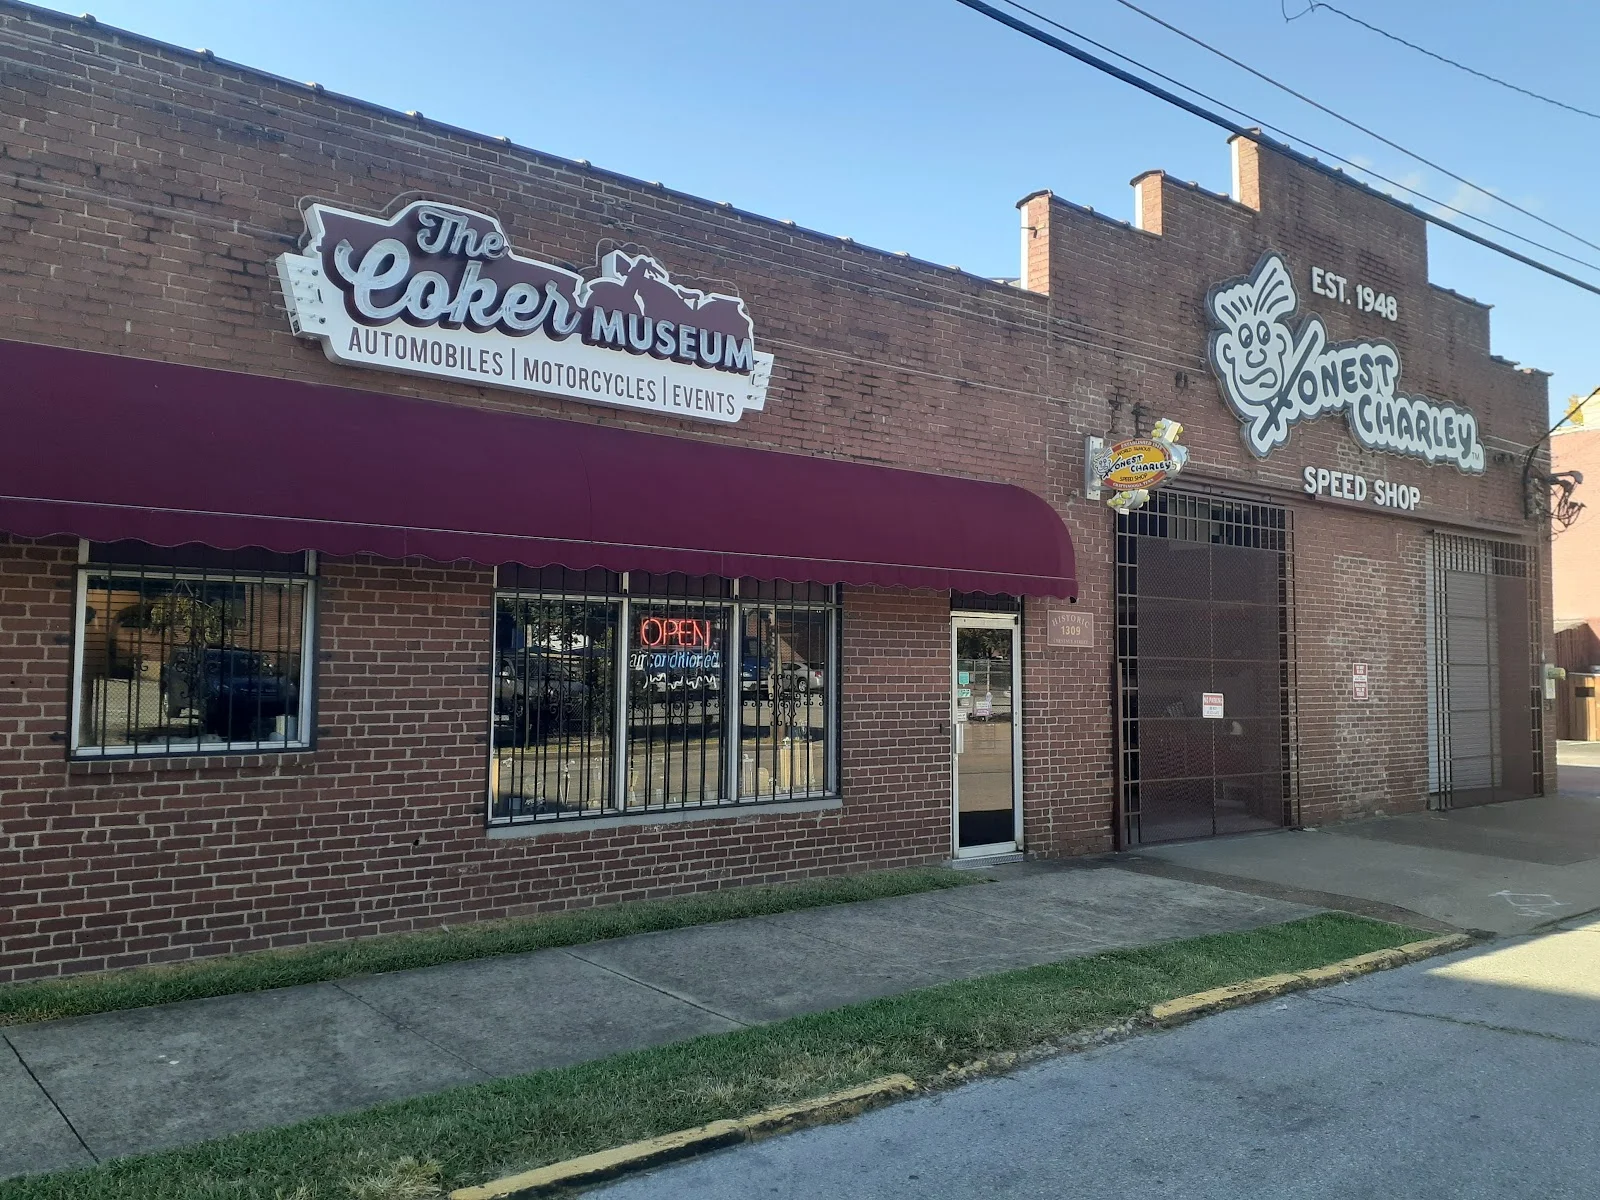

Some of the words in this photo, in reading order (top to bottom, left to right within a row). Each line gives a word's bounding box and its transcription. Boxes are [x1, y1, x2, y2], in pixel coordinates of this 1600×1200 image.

[416, 206, 508, 260] The
[334, 238, 581, 336] Coker
[1312, 266, 1351, 305] EST.
[1356, 284, 1399, 322] 1948
[591, 306, 755, 373] MUSEUM
[348, 326, 504, 377] AUTOMOBILES
[523, 356, 657, 403] MOTORCYCLES
[672, 383, 736, 416] EVENTS
[1358, 394, 1473, 460] CHARLEY
[1130, 461, 1171, 473] CHARLEY
[1303, 466, 1367, 502] SPEED
[1374, 479, 1421, 511] SHOP
[641, 618, 711, 646] OPEN
[1052, 614, 1090, 629] HISTORIC
[1061, 625, 1081, 636] 1309
